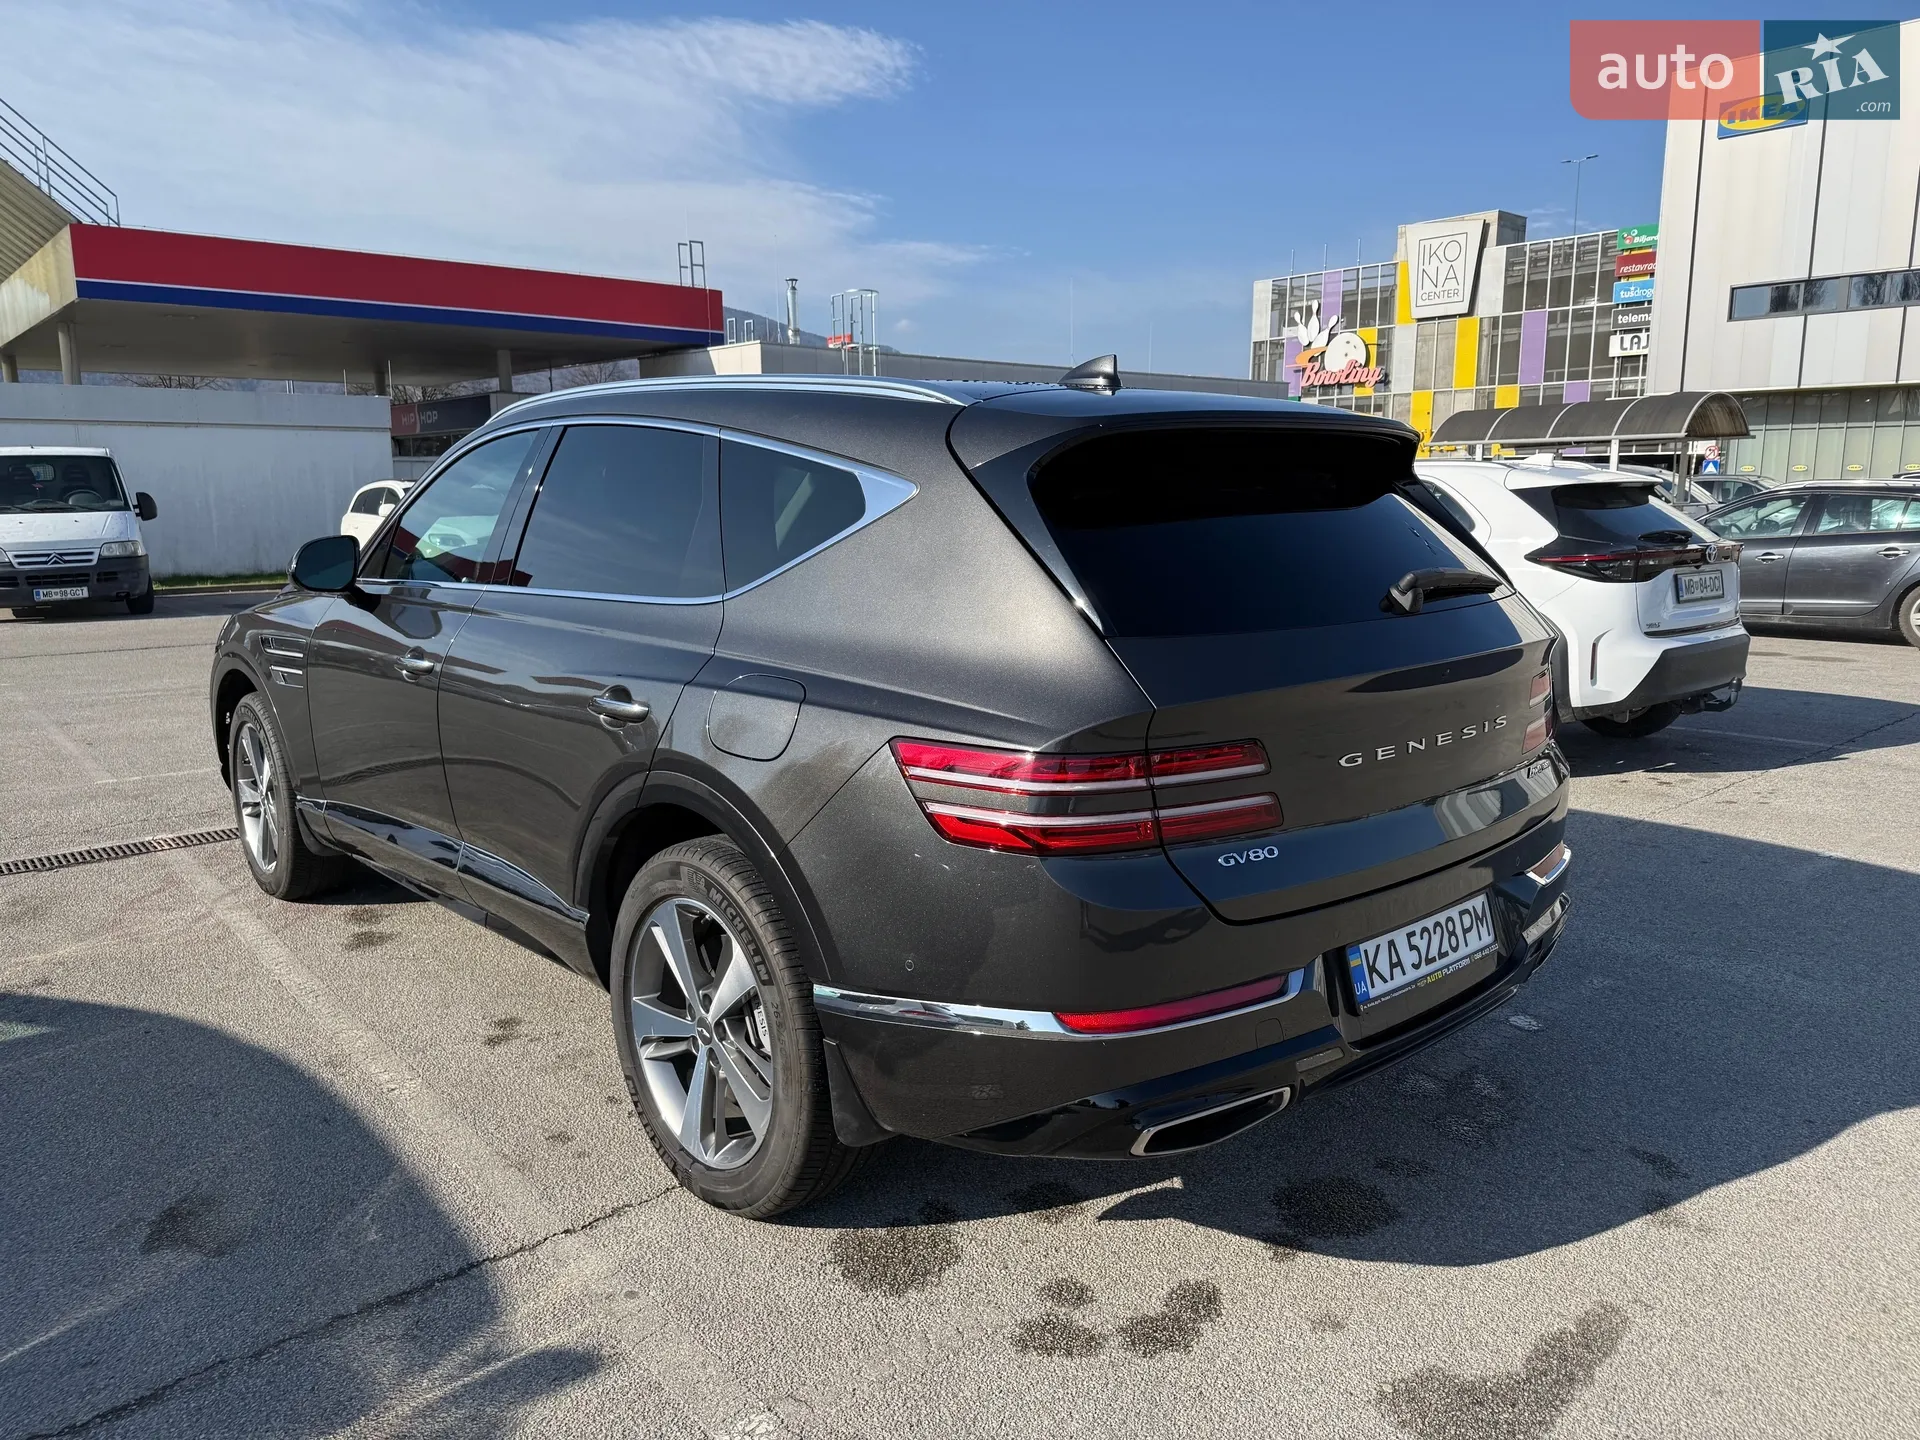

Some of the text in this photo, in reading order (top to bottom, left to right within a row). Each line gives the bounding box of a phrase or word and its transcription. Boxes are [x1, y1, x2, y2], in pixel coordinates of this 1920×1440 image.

[1727, 102, 1799, 125] IKEA
[1422, 240, 1462, 266] IKO
[1421, 264, 1460, 290] NA
[1421, 288, 1460, 301] CENTER
[1300, 358, 1383, 388] Bowling
[401, 410, 438, 426] HIP HOP
[1684, 578, 1695, 595] MB
[1338, 714, 1508, 768] GENESIS
[1217, 845, 1279, 867] GV80
[708, 886, 770, 982] MICHELIN
[1364, 900, 1492, 989] KA 5228 PM
[1426, 971, 1443, 984] AUTO
[1441, 957, 1471, 976] PLATFORM
[1354, 983, 1368, 995] UA
